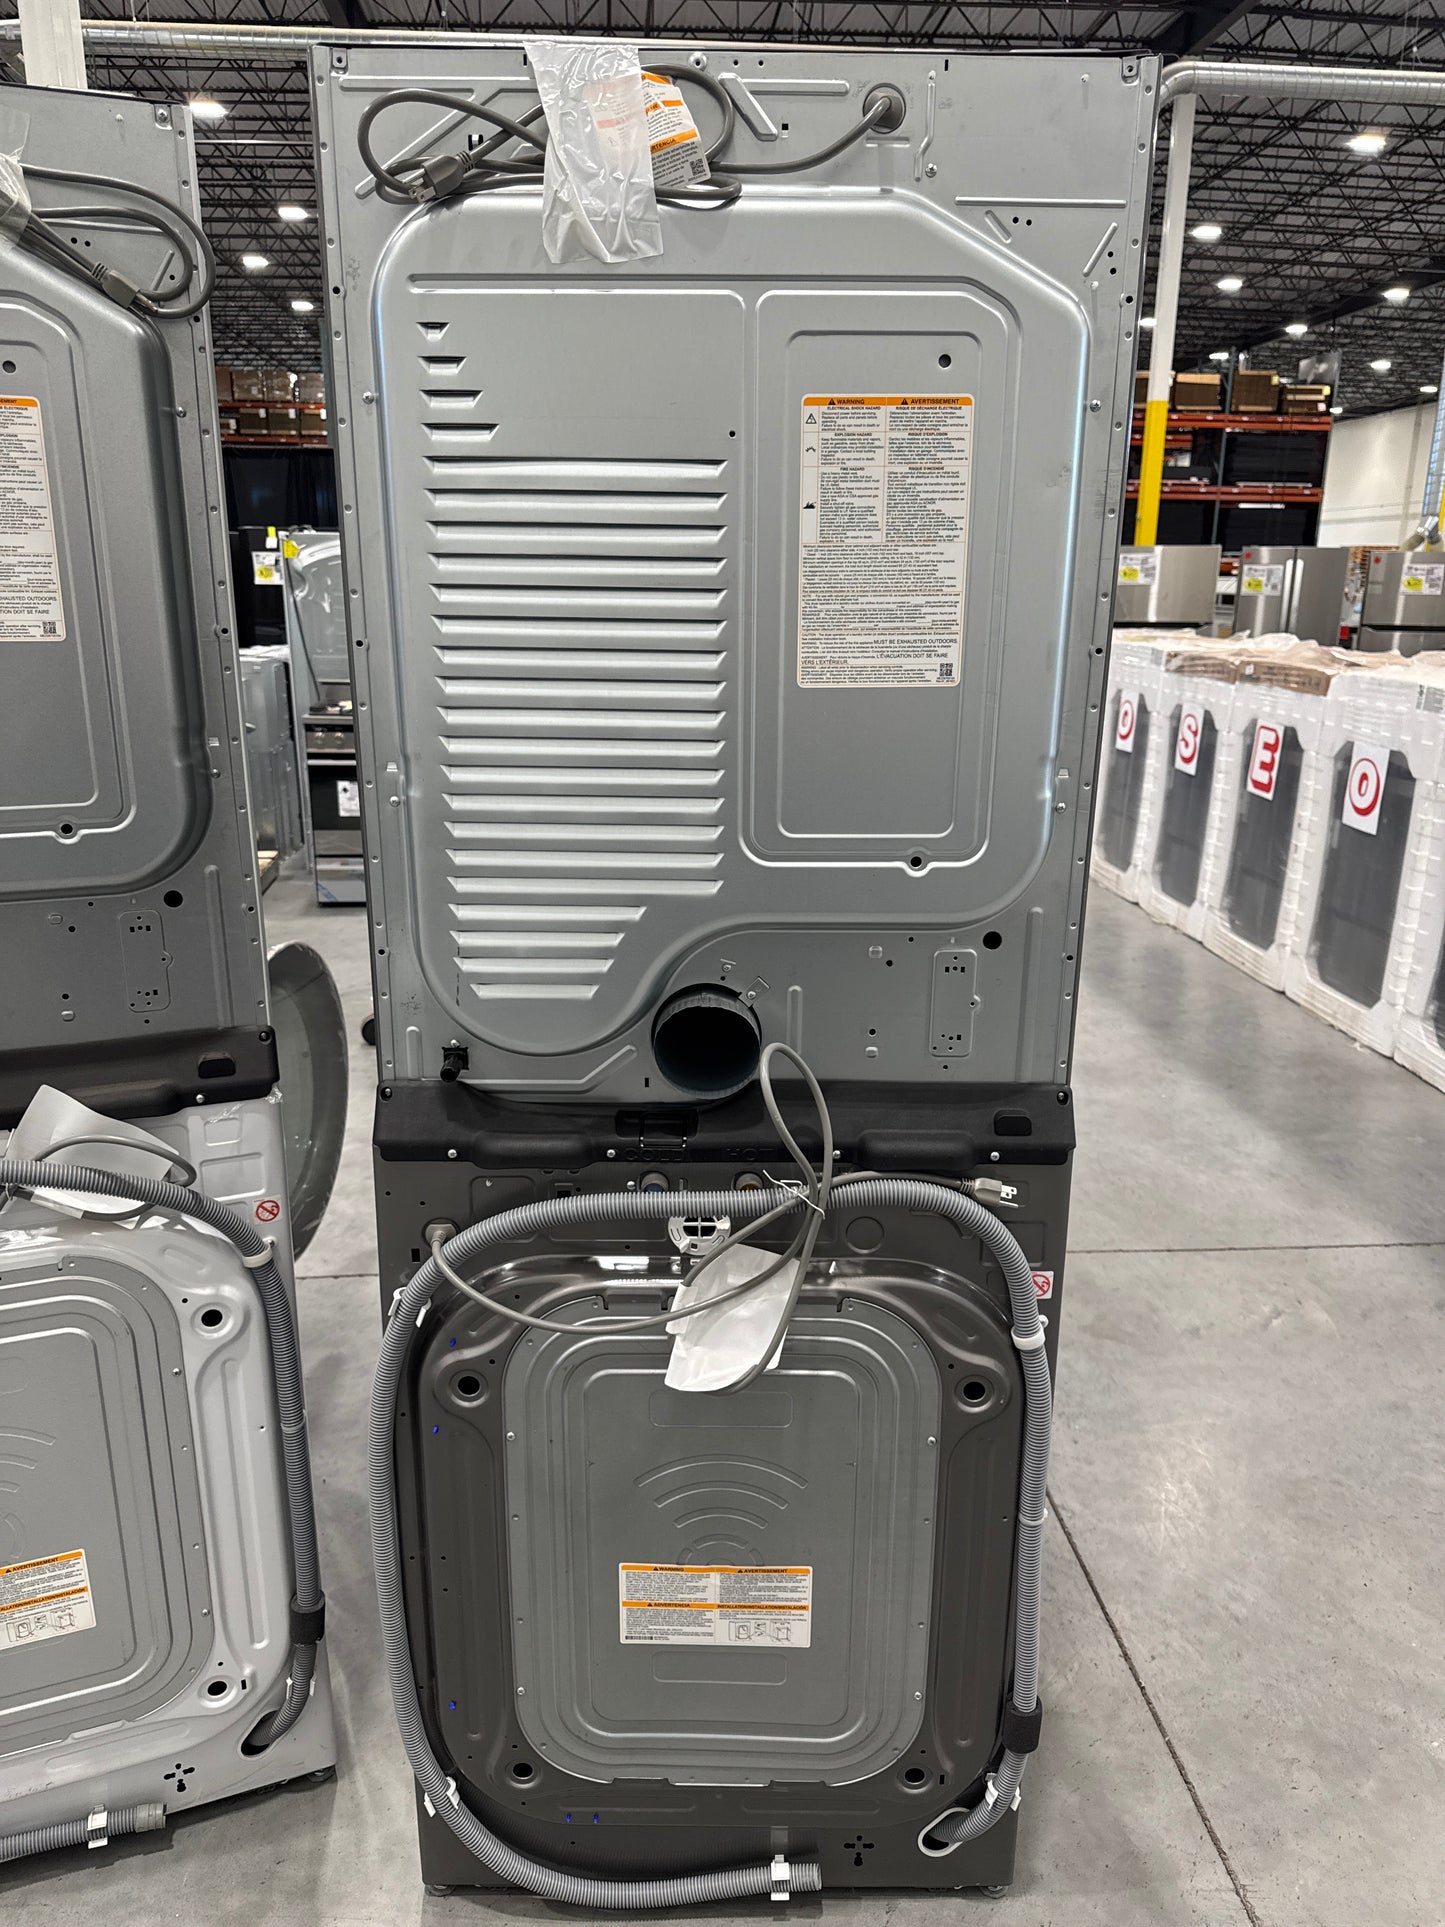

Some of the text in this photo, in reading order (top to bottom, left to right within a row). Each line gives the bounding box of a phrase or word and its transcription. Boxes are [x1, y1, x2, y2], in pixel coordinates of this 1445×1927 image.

[1118, 699, 1135, 740] O
[1178, 714, 1198, 764] S
[1250, 725, 1279, 793] E
[1349, 758, 1381, 817] O
[12, 1557, 58, 1571] AVERTISSEMENT
[0, 1588, 85, 1611] ALLATION/INSTALLATION/INSTALACIÓN
